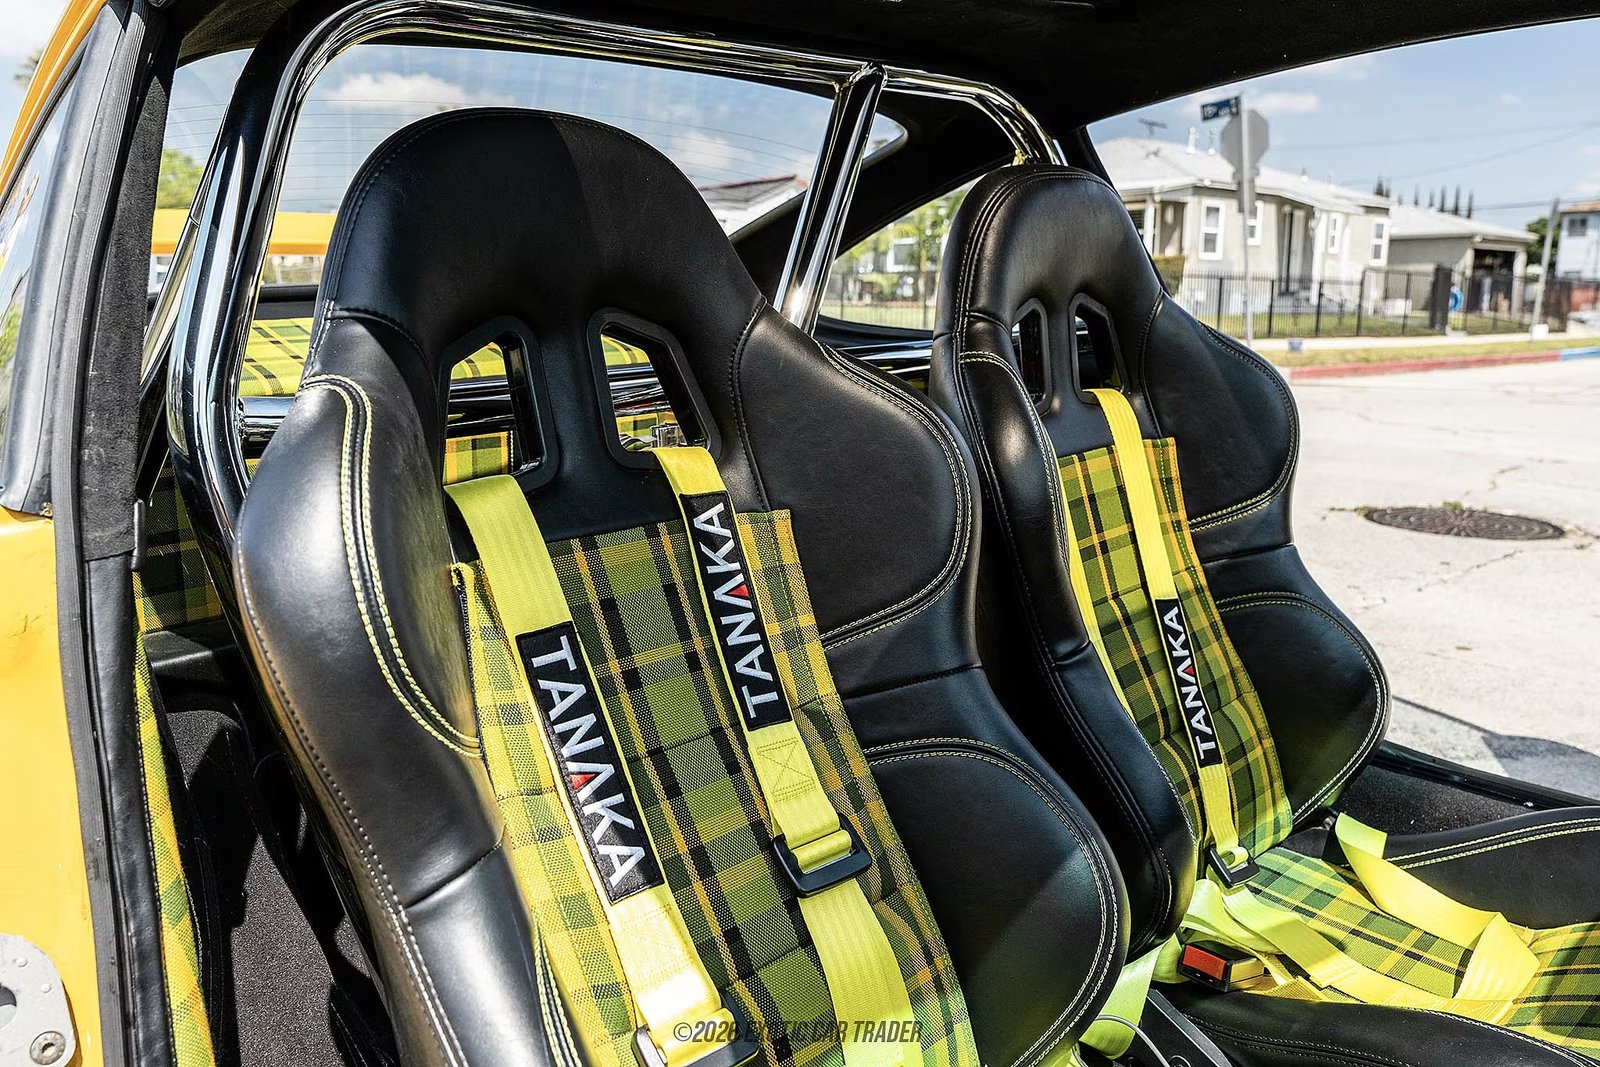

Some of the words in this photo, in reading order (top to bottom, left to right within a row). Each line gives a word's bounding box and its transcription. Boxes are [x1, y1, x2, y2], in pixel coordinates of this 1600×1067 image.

[693, 501, 780, 719] TANAKA
[1163, 606, 1217, 760] TANAKA
[530, 635, 647, 890] TANAKA
